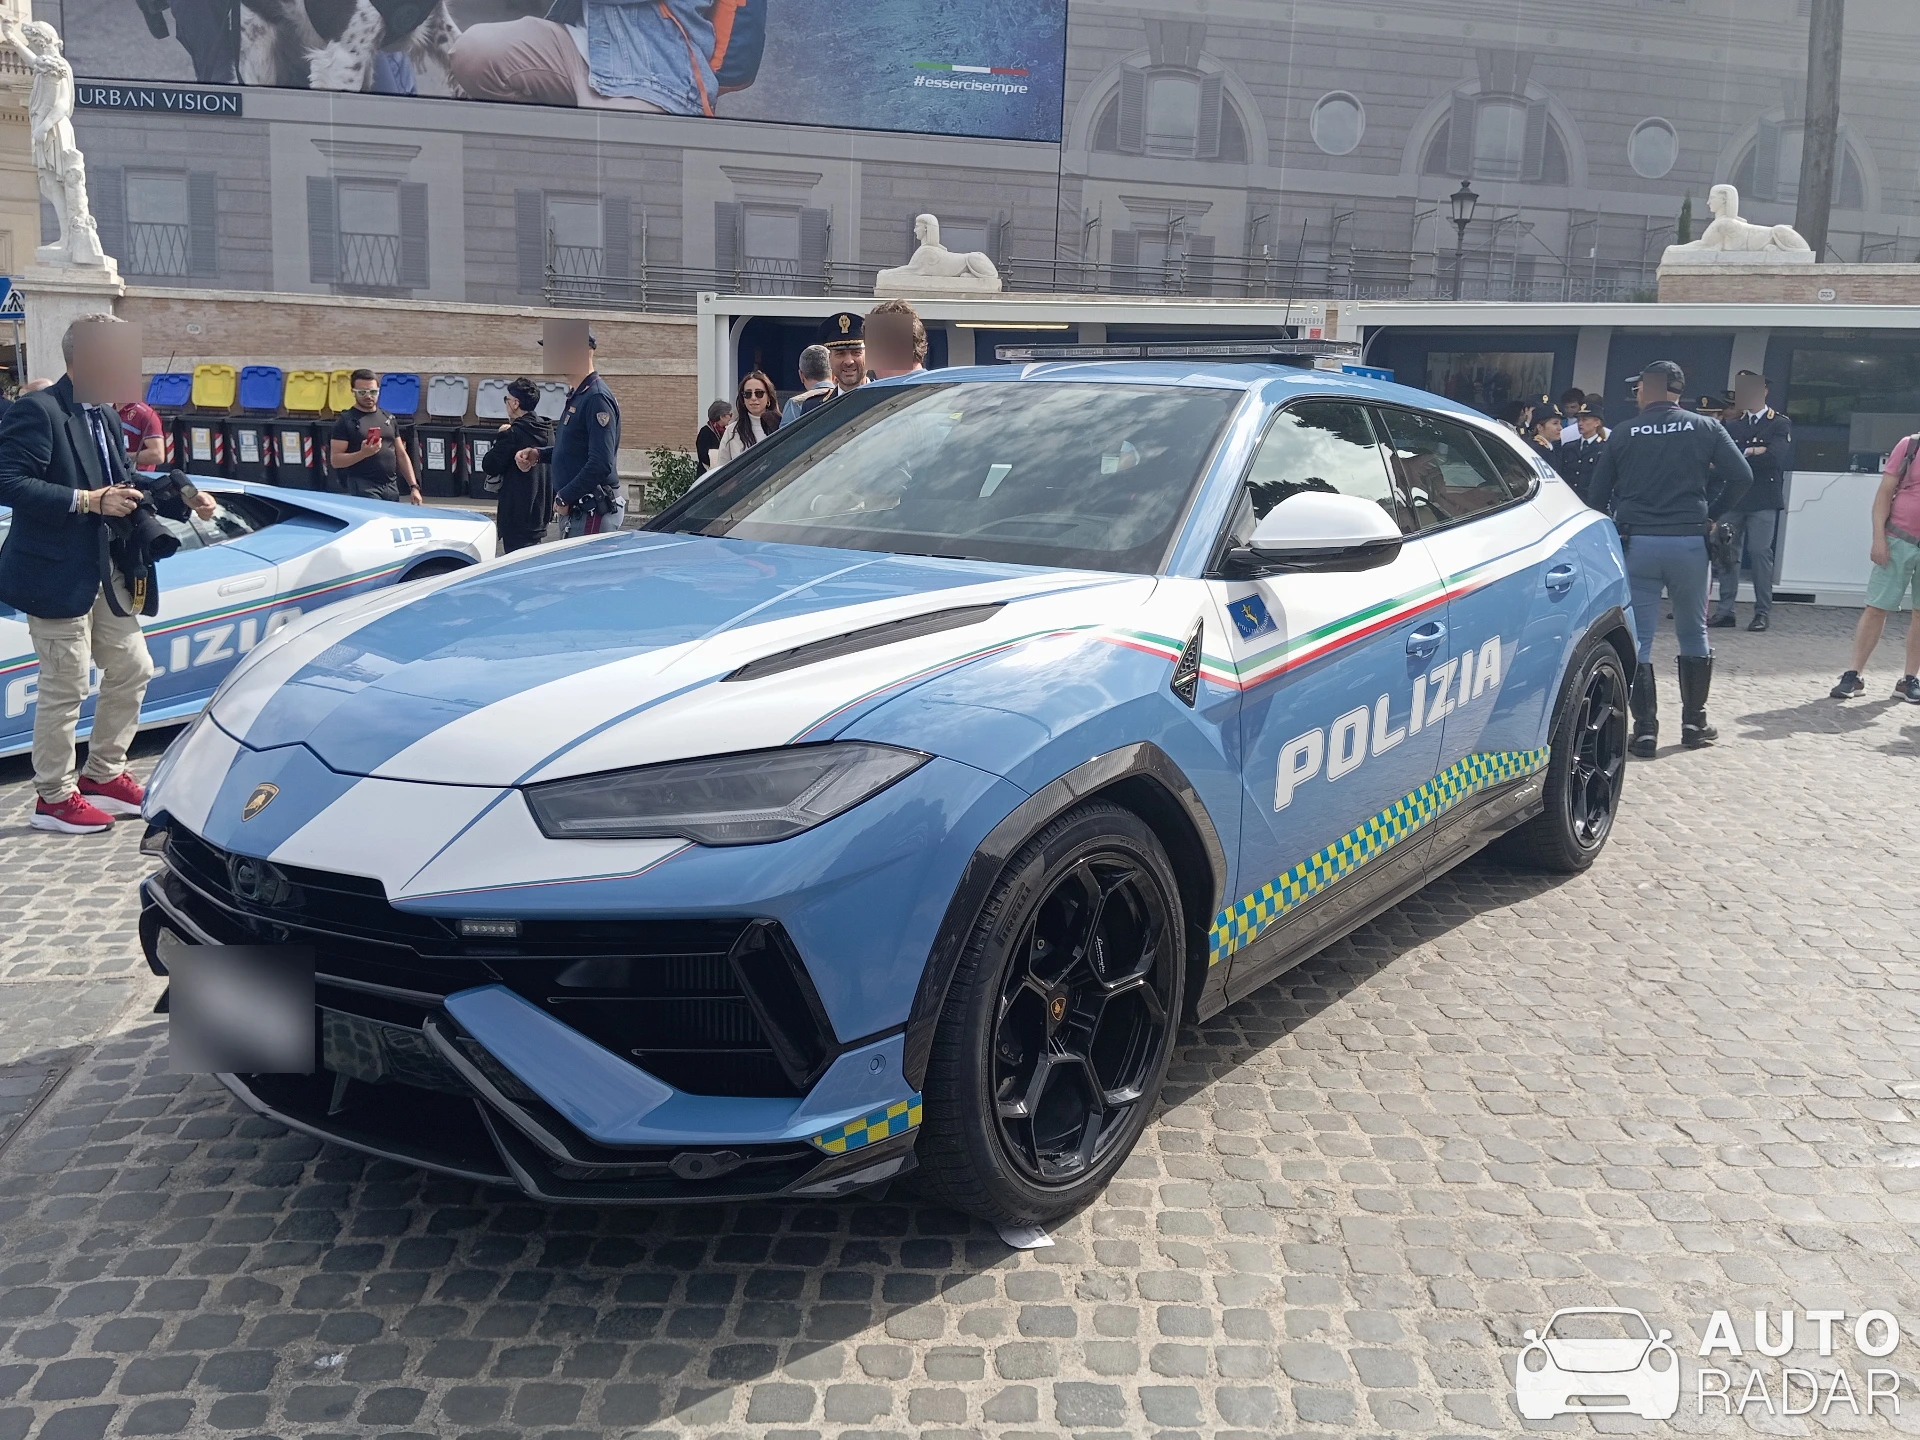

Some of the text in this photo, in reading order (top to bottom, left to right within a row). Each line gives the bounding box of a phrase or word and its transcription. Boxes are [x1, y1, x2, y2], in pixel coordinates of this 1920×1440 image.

[913, 75, 1028, 95] #essercisempre
[78, 87, 237, 112] URBAN VISION
[1630, 421, 1695, 437] POLIZIA
[390, 526, 432, 543] 113
[1273, 634, 1501, 813] POLIZIA
[994, 881, 1031, 948] PIRELLI
